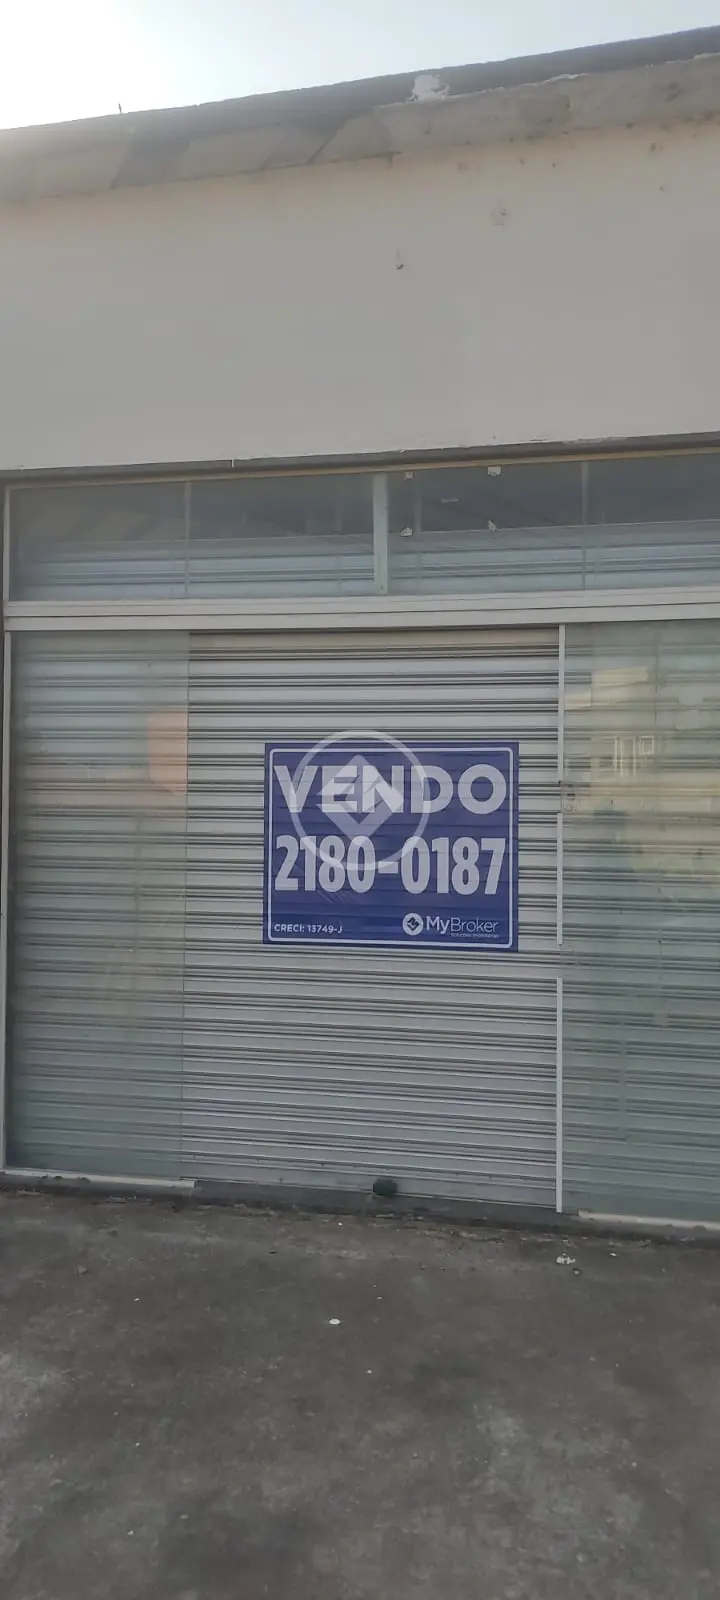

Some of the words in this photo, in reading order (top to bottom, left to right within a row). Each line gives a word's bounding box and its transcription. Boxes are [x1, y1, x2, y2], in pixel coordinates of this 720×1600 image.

[273, 764, 507, 814] VENDO
[274, 835, 506, 895] 2180-0187
[274, 924, 305, 933] CRECI:
[307, 924, 343, 934] 13749-J
[426, 916, 499, 934] MyBroker
